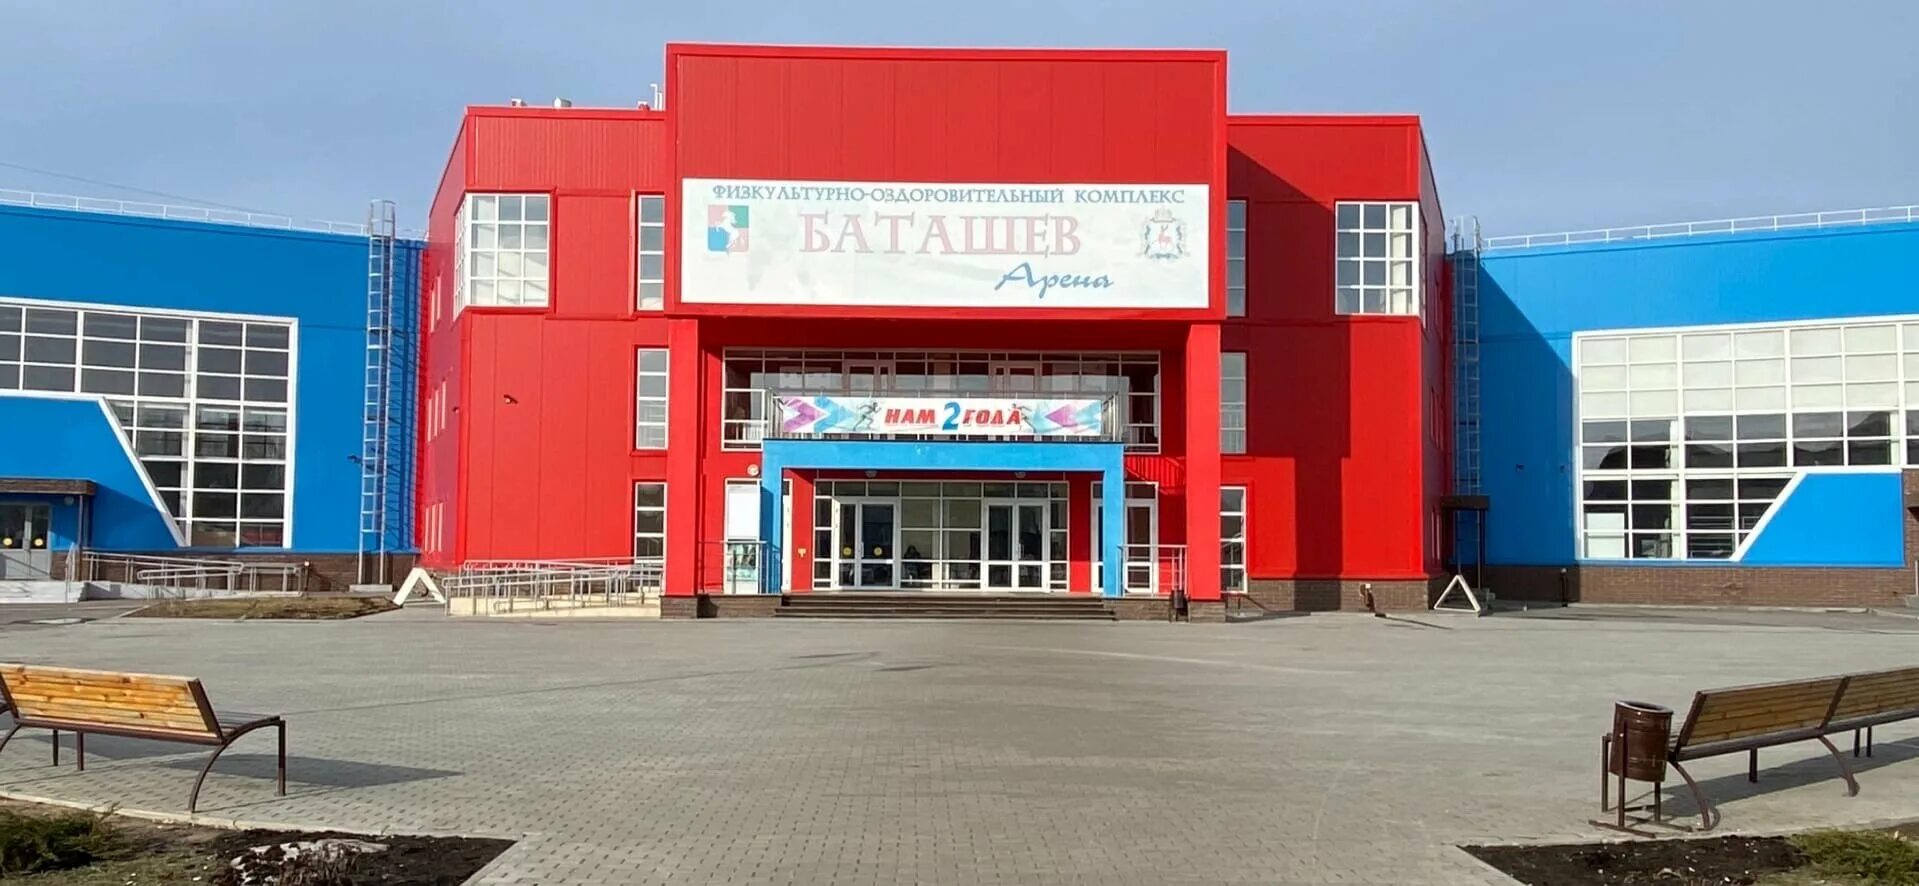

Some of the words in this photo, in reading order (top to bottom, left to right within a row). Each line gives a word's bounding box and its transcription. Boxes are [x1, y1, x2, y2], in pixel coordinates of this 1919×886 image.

[712, 184, 1064, 203] ФИЗКУЛЬТУРНО-ОЗДОРОВИТЕЛЬНЫЙ
[1075, 189, 1185, 204] КОМПЛЕКС
[799, 209, 1082, 258] БАТАШЕВ
[994, 261, 1115, 299] Арена
[884, 407, 937, 425] НАМ
[942, 401, 962, 432] 2
[962, 408, 1022, 426] ГОДА
